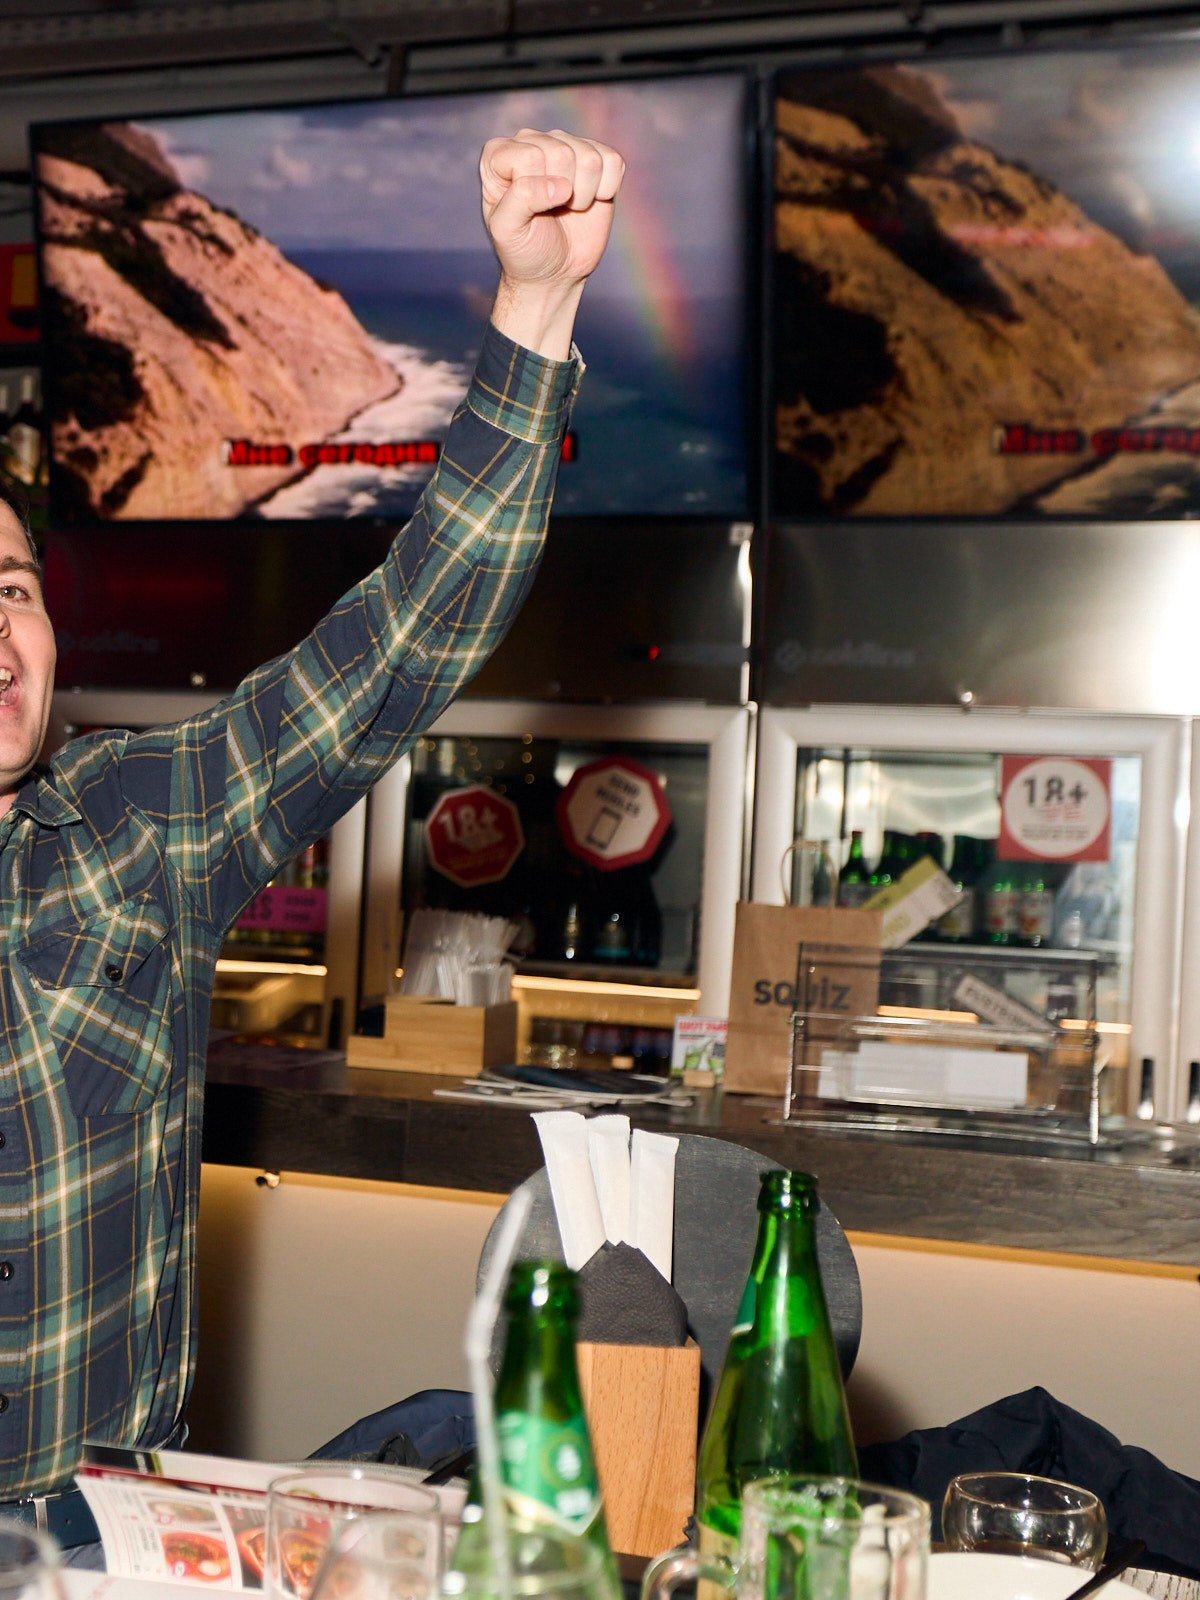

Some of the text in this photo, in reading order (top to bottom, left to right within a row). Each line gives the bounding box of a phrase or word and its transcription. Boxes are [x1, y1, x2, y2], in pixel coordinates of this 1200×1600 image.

[221, 438, 438, 468] Мне сегодня
[1022, 774, 1089, 807] 18+
